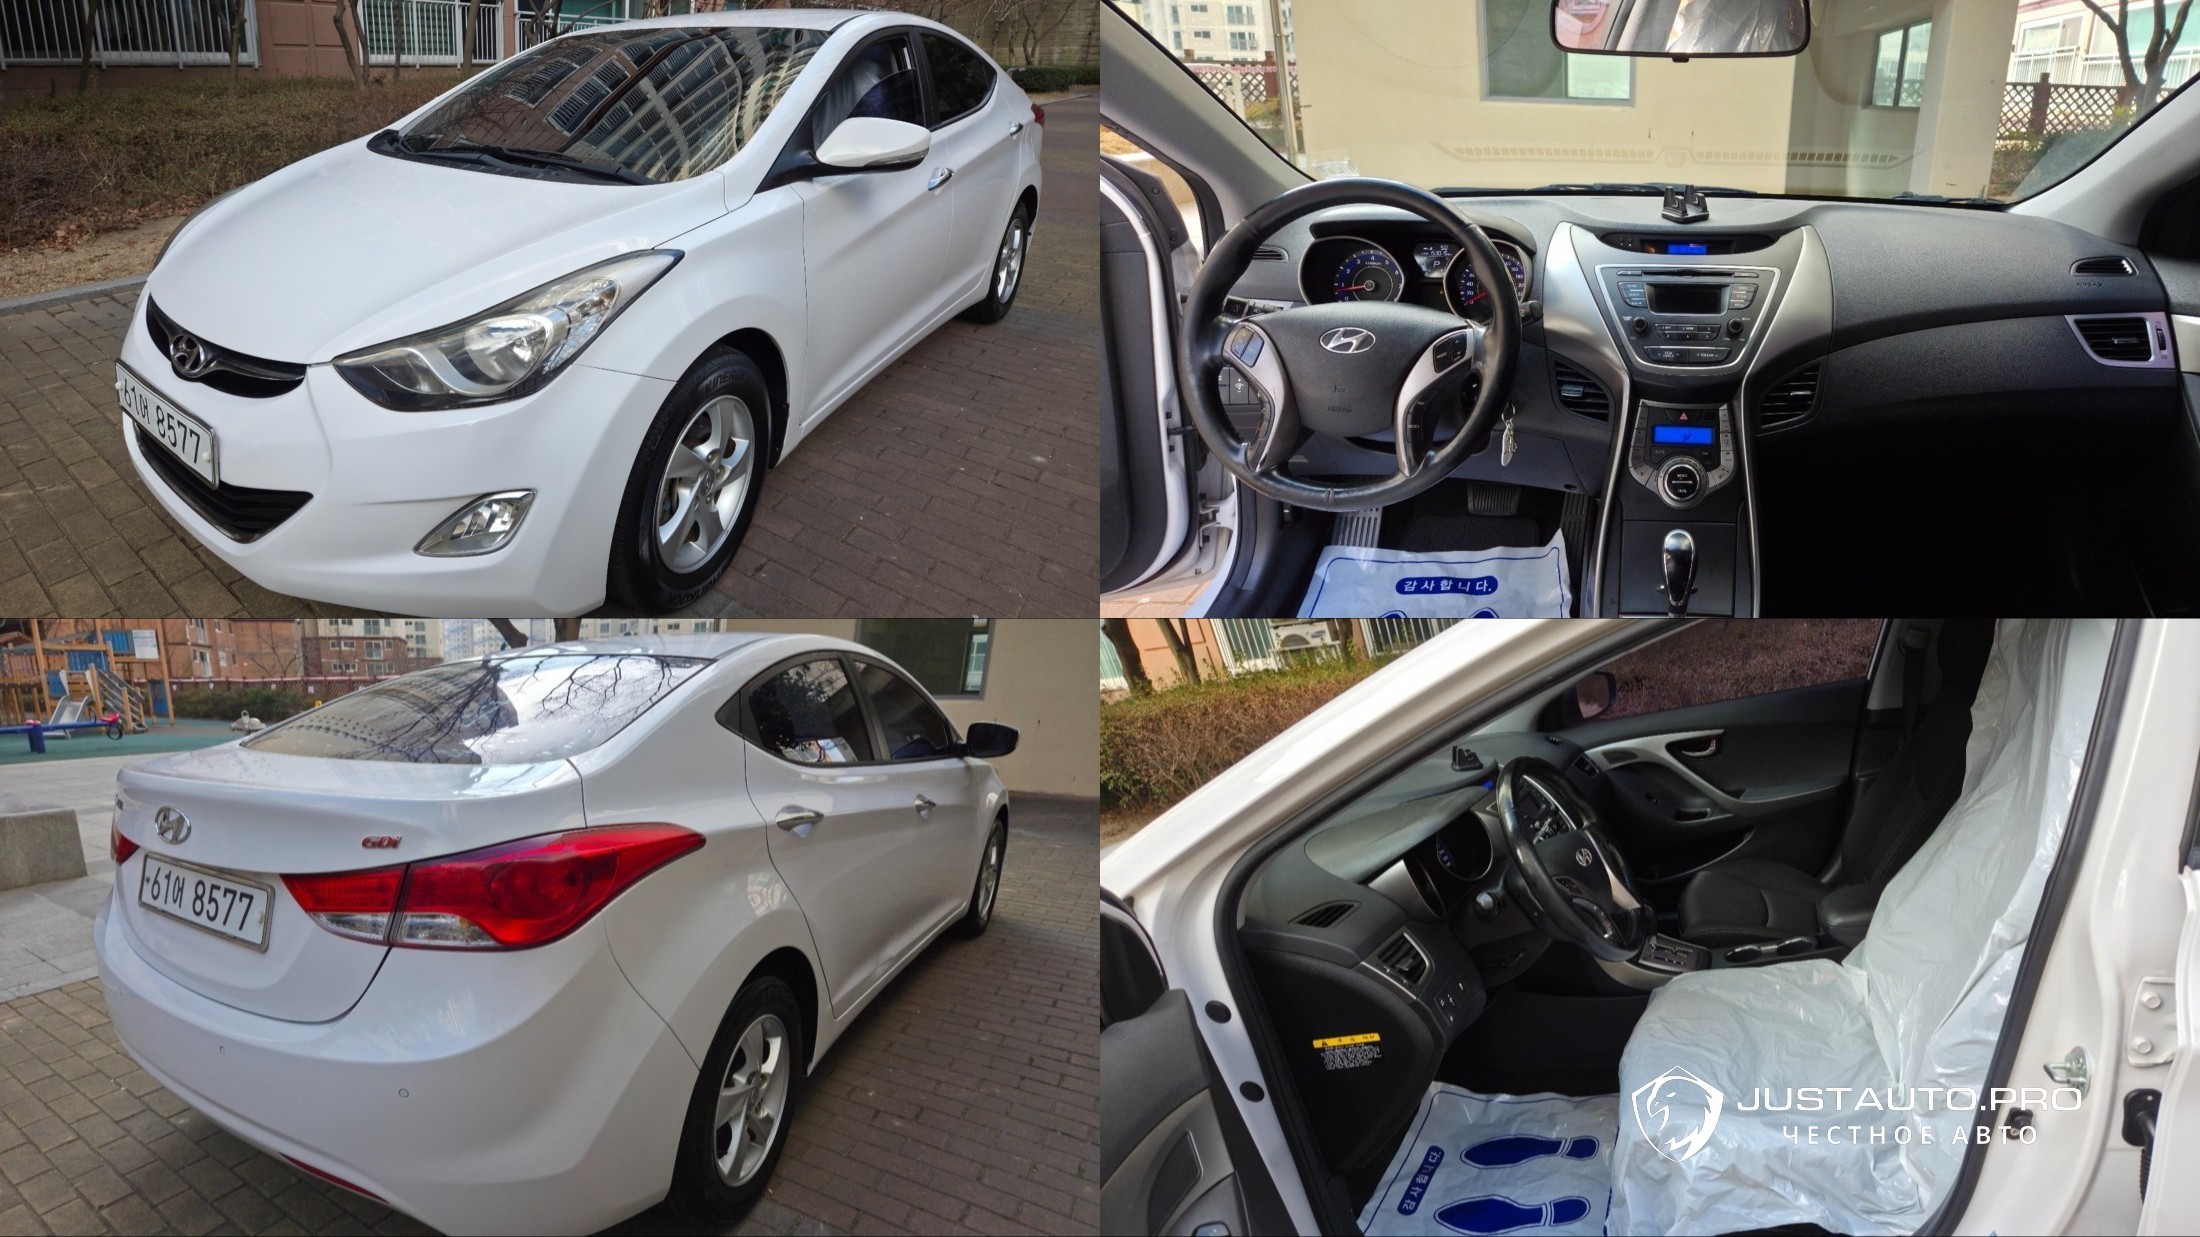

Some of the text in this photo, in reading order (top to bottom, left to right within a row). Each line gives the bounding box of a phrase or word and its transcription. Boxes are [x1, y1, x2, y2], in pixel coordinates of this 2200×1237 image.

[155, 404, 201, 464] 8577
[150, 867, 254, 931] 61어 8577
